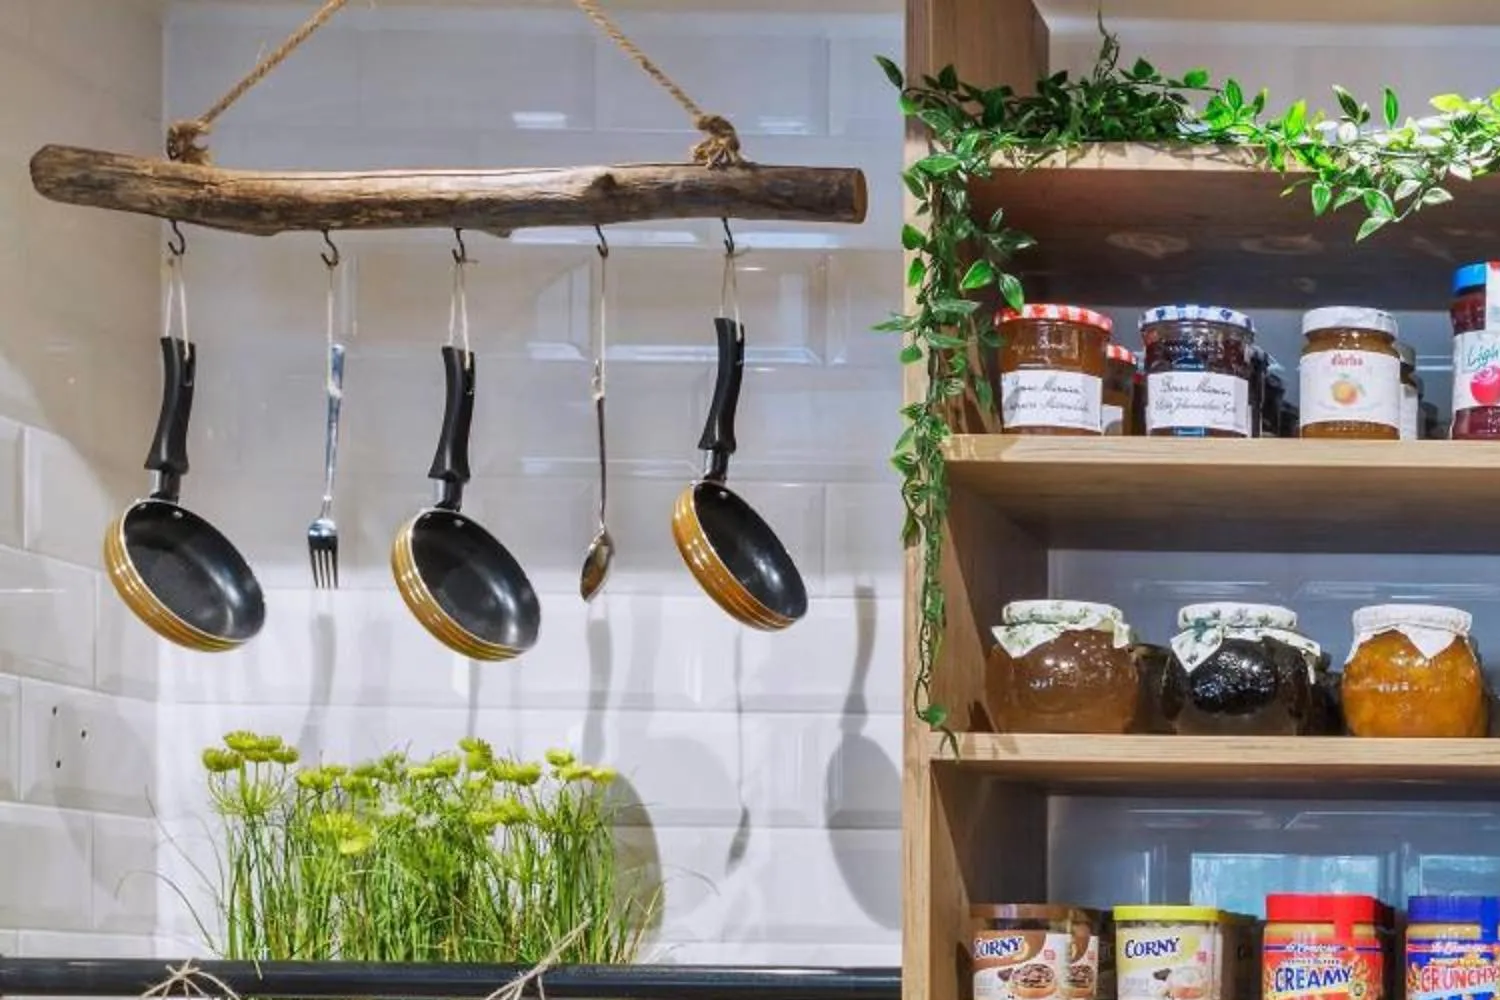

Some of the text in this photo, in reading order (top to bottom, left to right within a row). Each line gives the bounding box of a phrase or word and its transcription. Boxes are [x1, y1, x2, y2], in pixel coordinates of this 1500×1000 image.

[1125, 937, 1180, 958] CORNY
[1275, 965, 1352, 993] CREAMY
[1421, 964, 1497, 993] CRUNCHY
